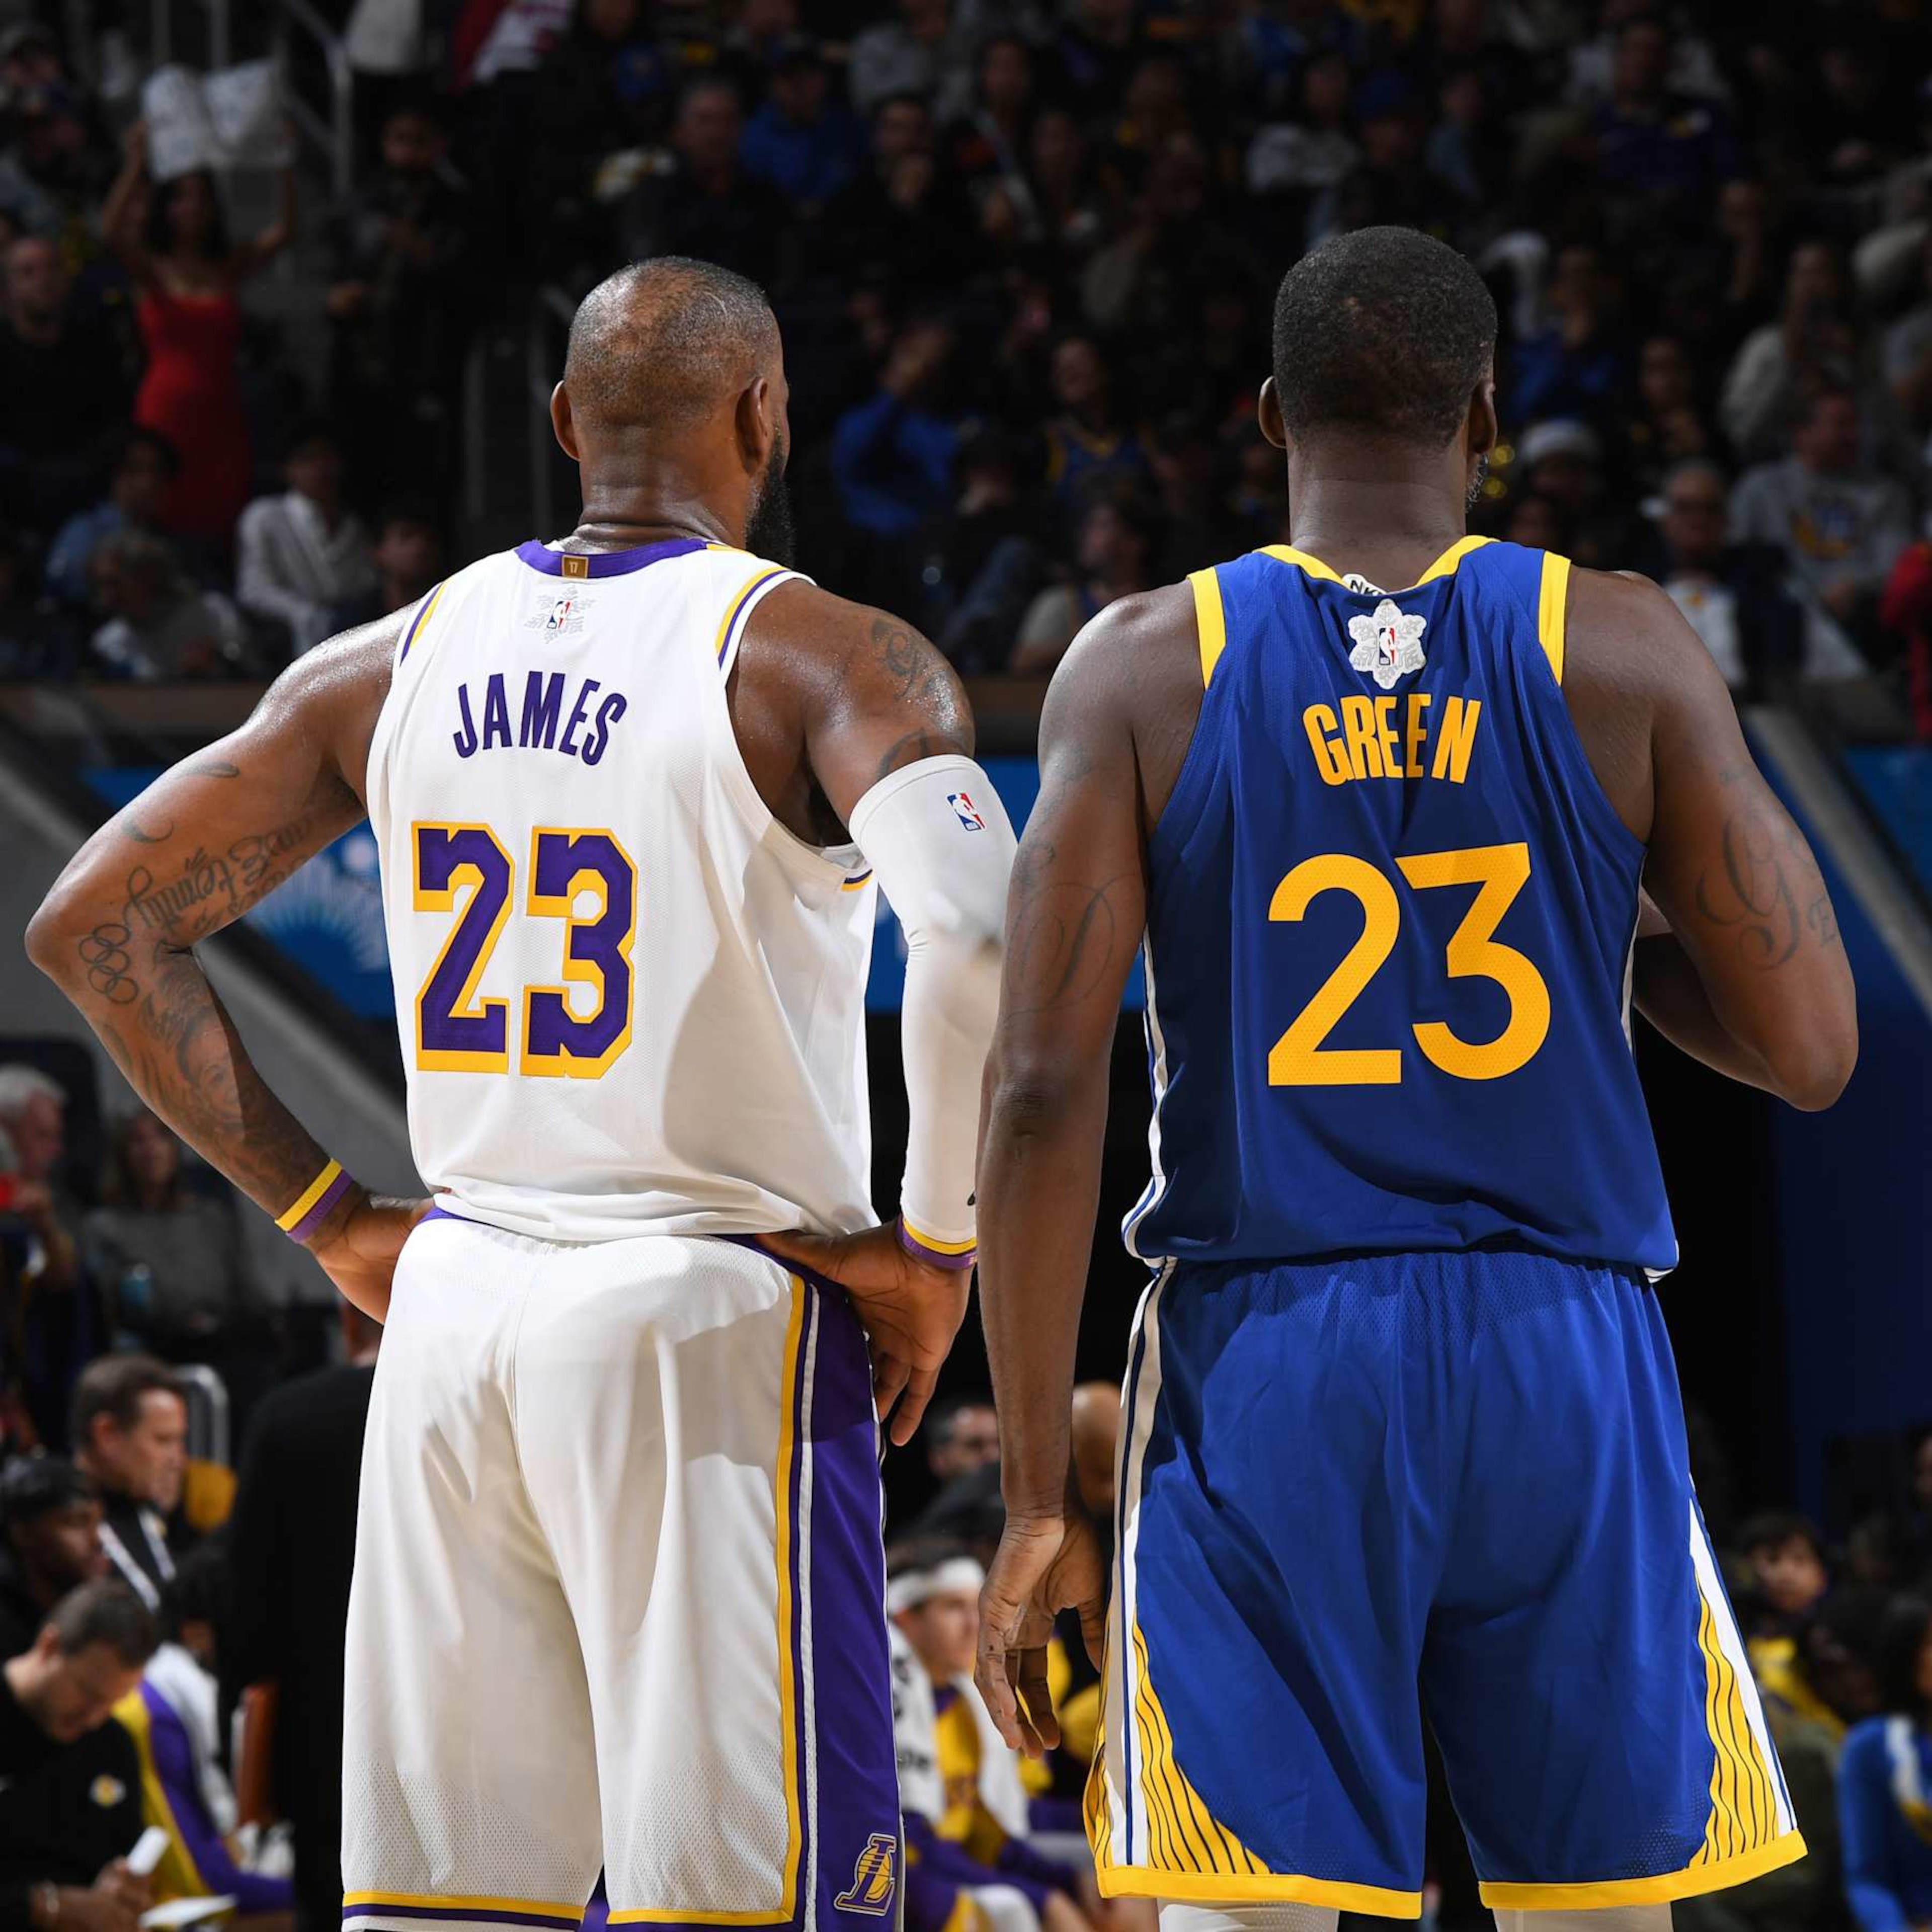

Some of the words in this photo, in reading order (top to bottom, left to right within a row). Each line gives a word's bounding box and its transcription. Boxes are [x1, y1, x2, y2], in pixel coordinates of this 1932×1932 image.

[453, 671, 627, 765] JAMES
[1302, 693, 1482, 785] GREEN
[411, 821, 638, 1080] 23
[1268, 842, 1551, 1086] 23
